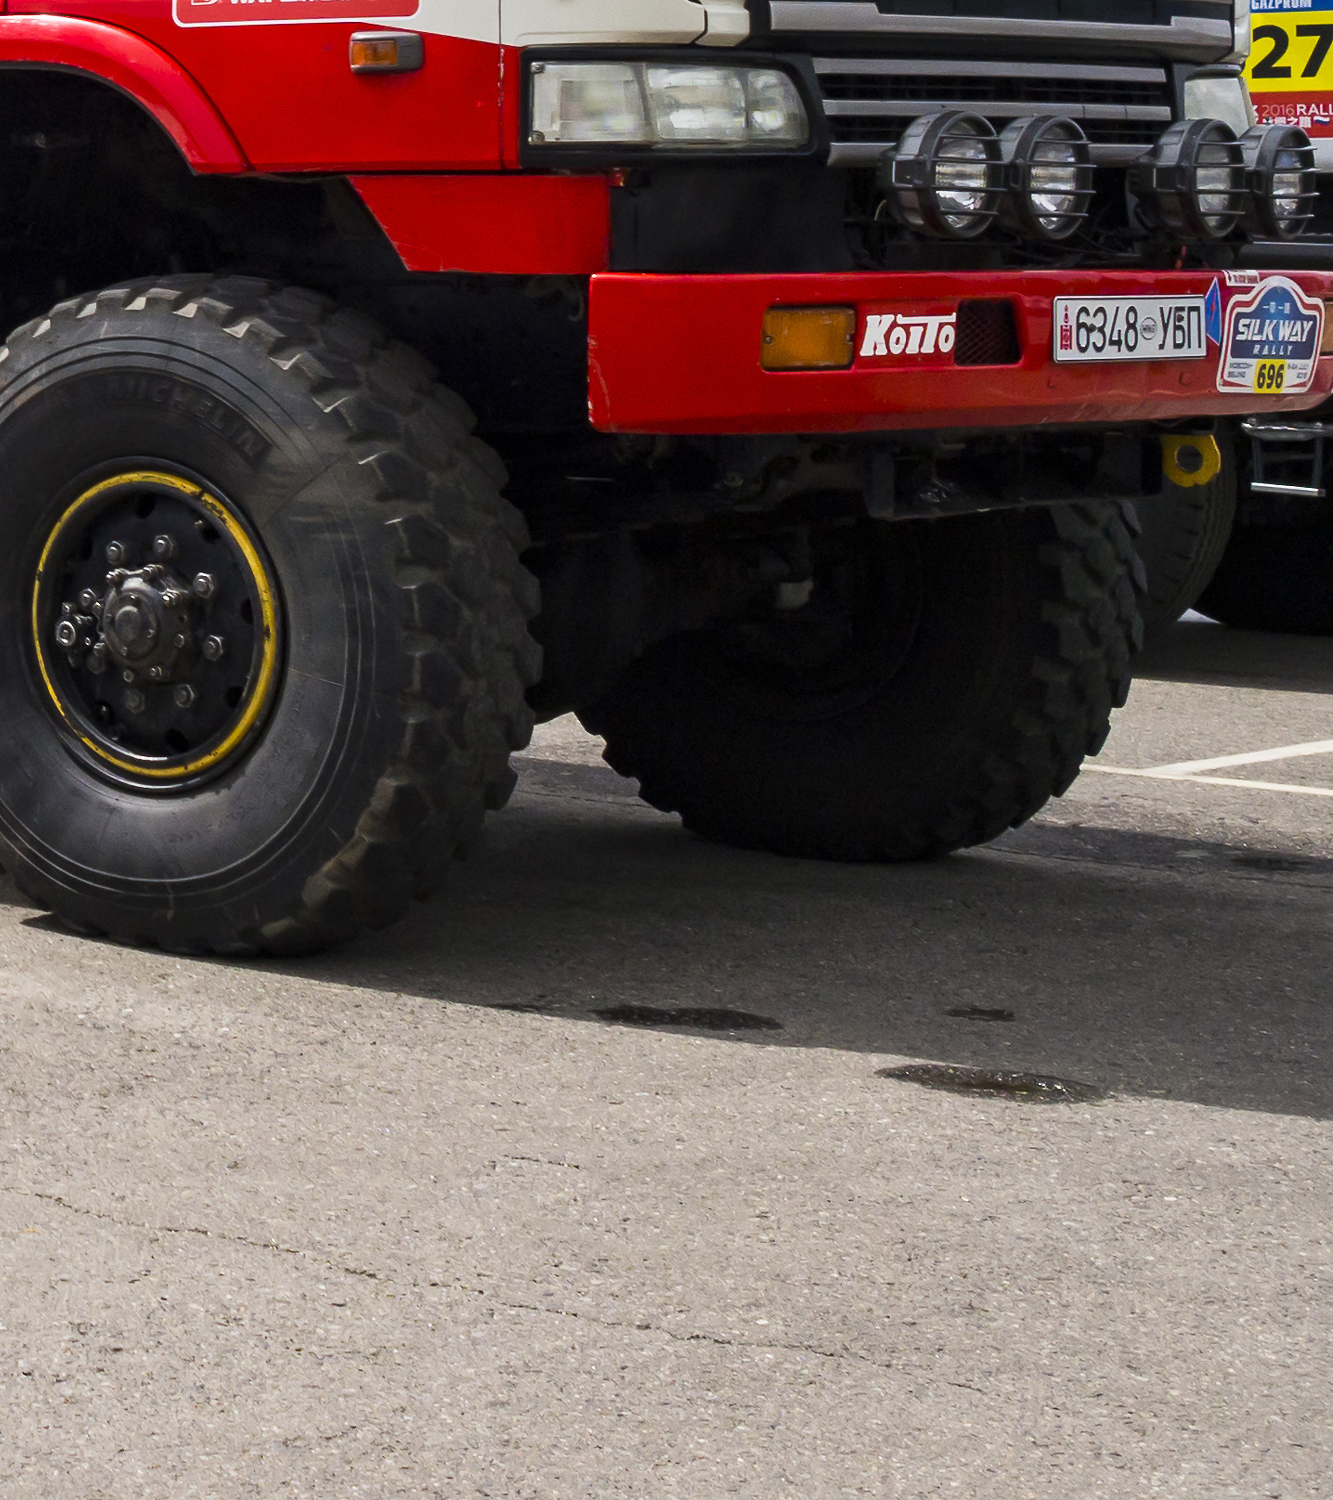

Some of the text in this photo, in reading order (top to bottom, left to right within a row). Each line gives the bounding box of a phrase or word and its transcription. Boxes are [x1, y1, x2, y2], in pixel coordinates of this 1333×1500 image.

[1261, 104, 1295, 117] 2016
[1076, 305, 1203, 353] 6348 УБП
[1236, 319, 1314, 342] SILK WAY
[1253, 344, 1294, 356] RALLY
[1256, 363, 1285, 389] 696
[105, 376, 276, 464] MICHELIN
